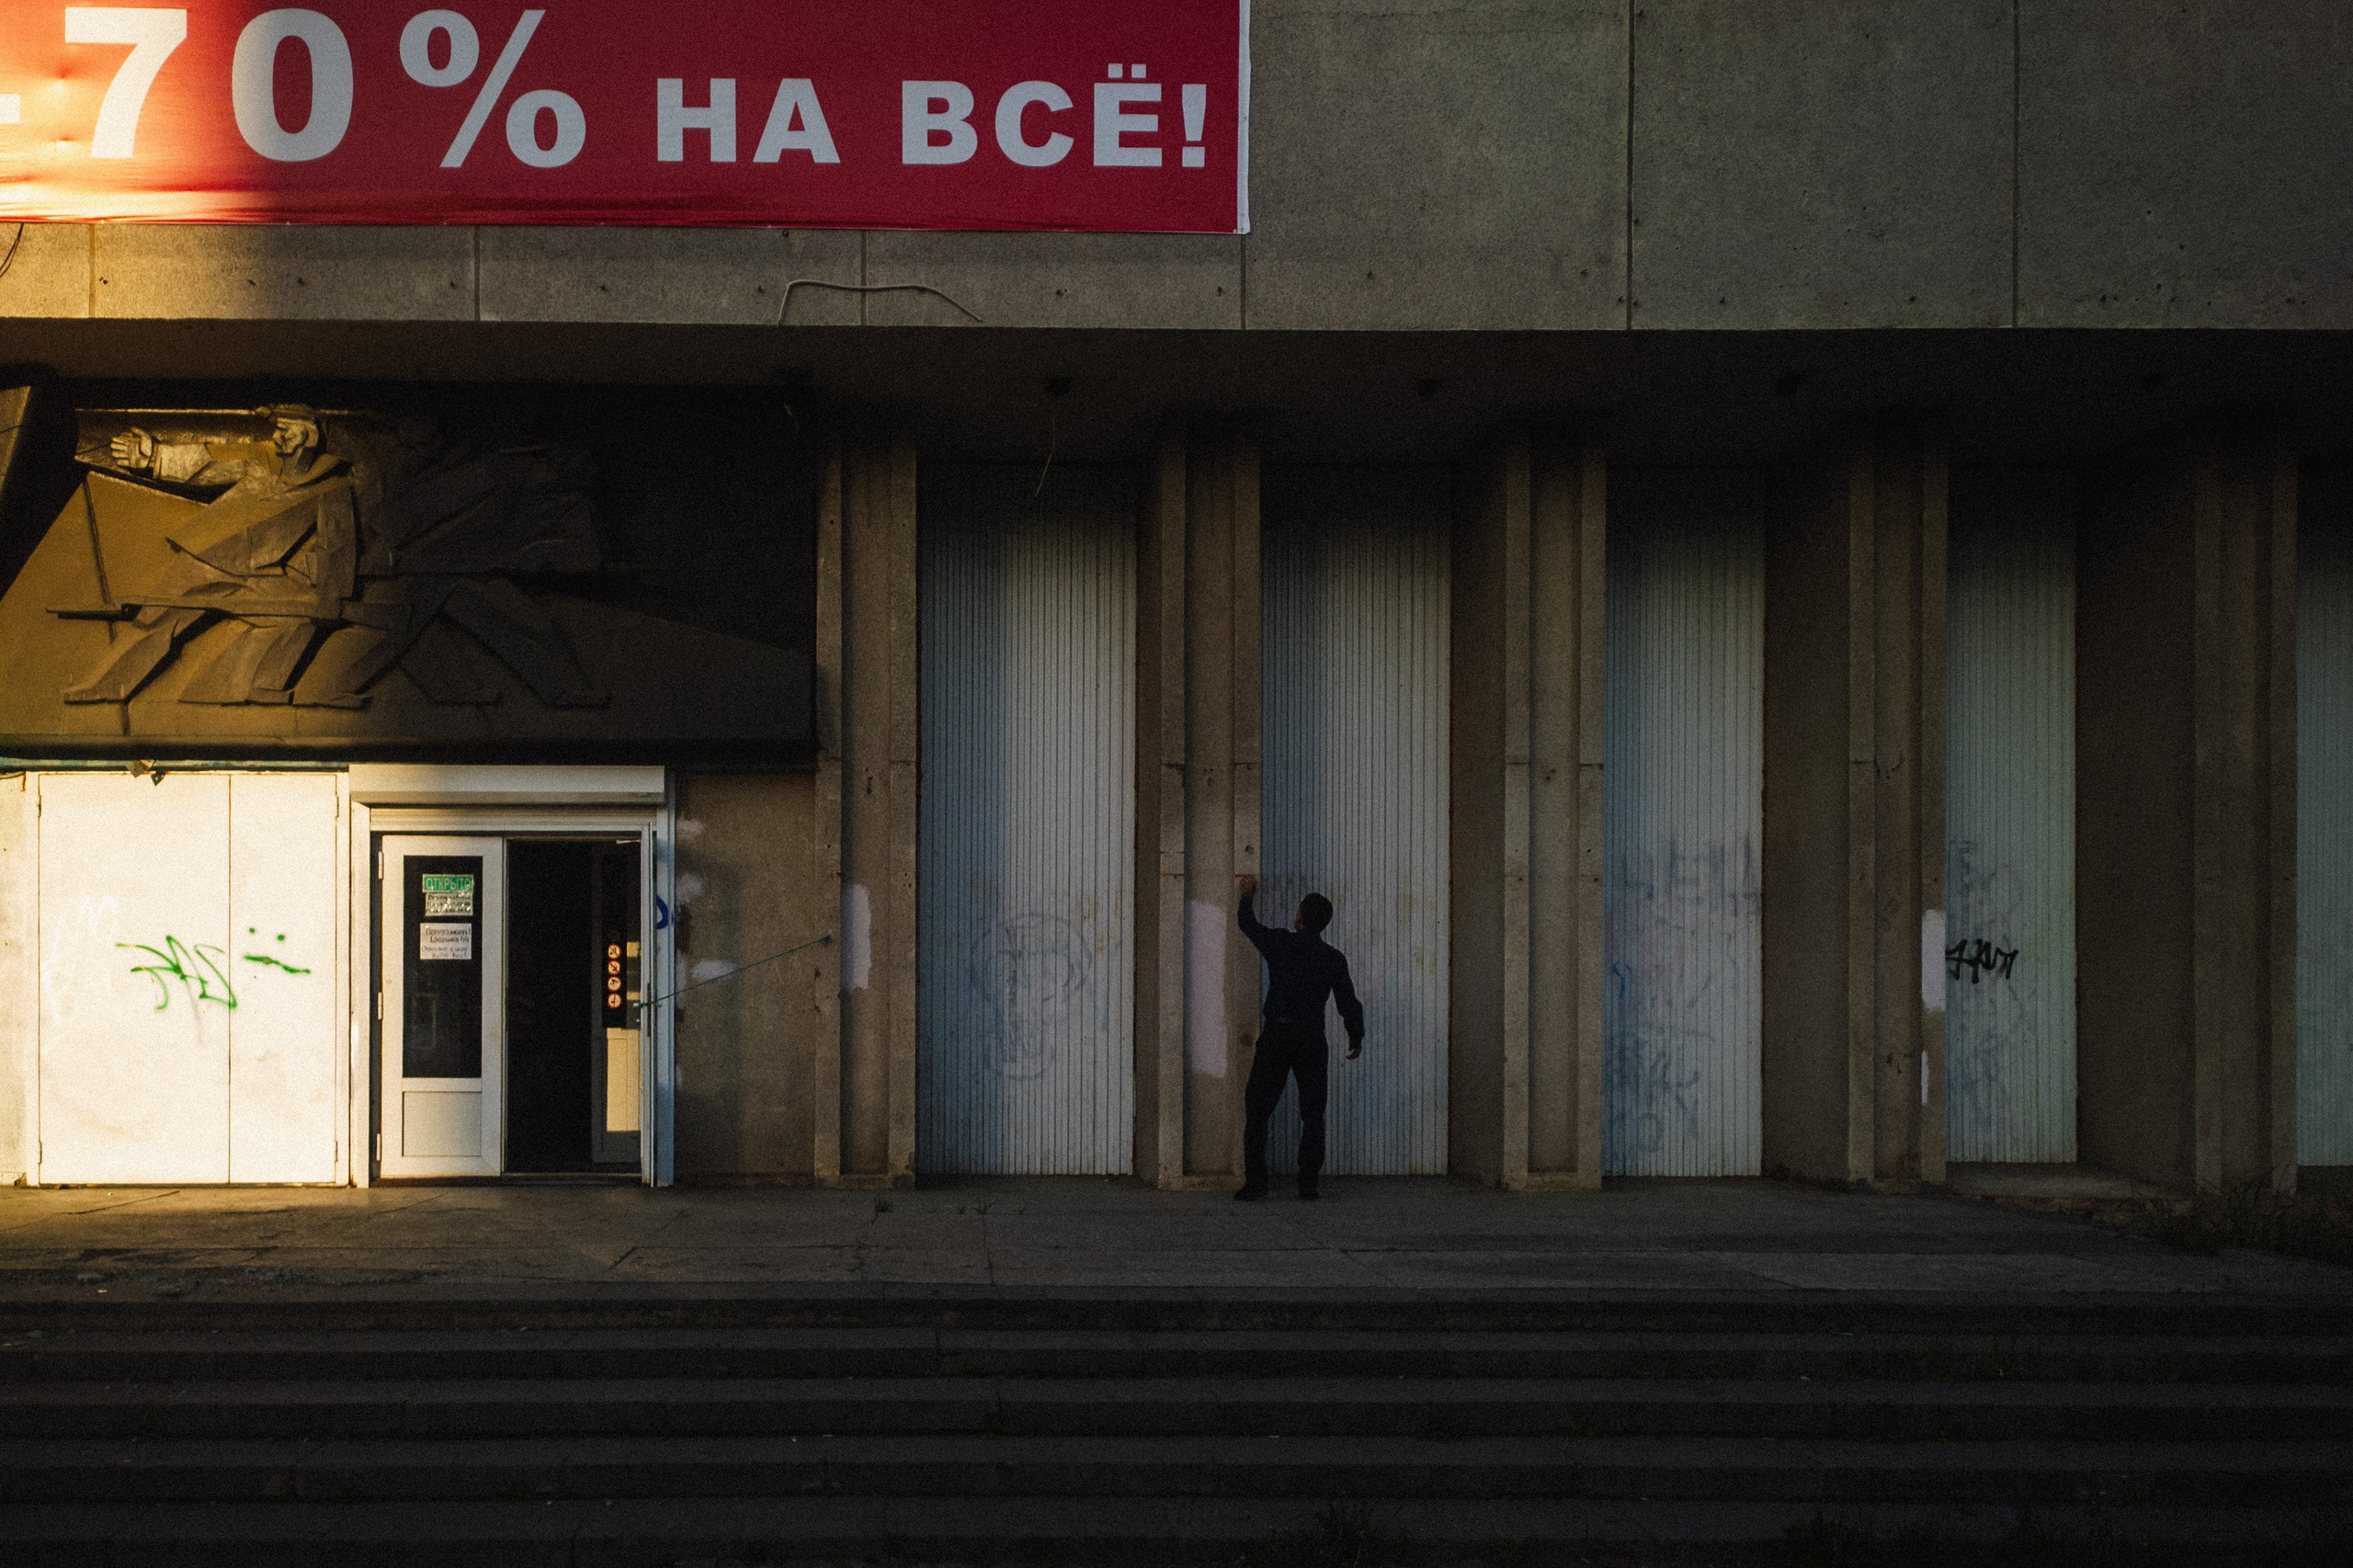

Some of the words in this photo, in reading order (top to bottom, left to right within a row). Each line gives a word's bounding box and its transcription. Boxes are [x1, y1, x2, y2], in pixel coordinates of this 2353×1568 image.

[656, 77, 841, 164] НА
[902, 62, 1207, 167] ВСЁ!
[426, 877, 472, 891] ОТКРЫТО
